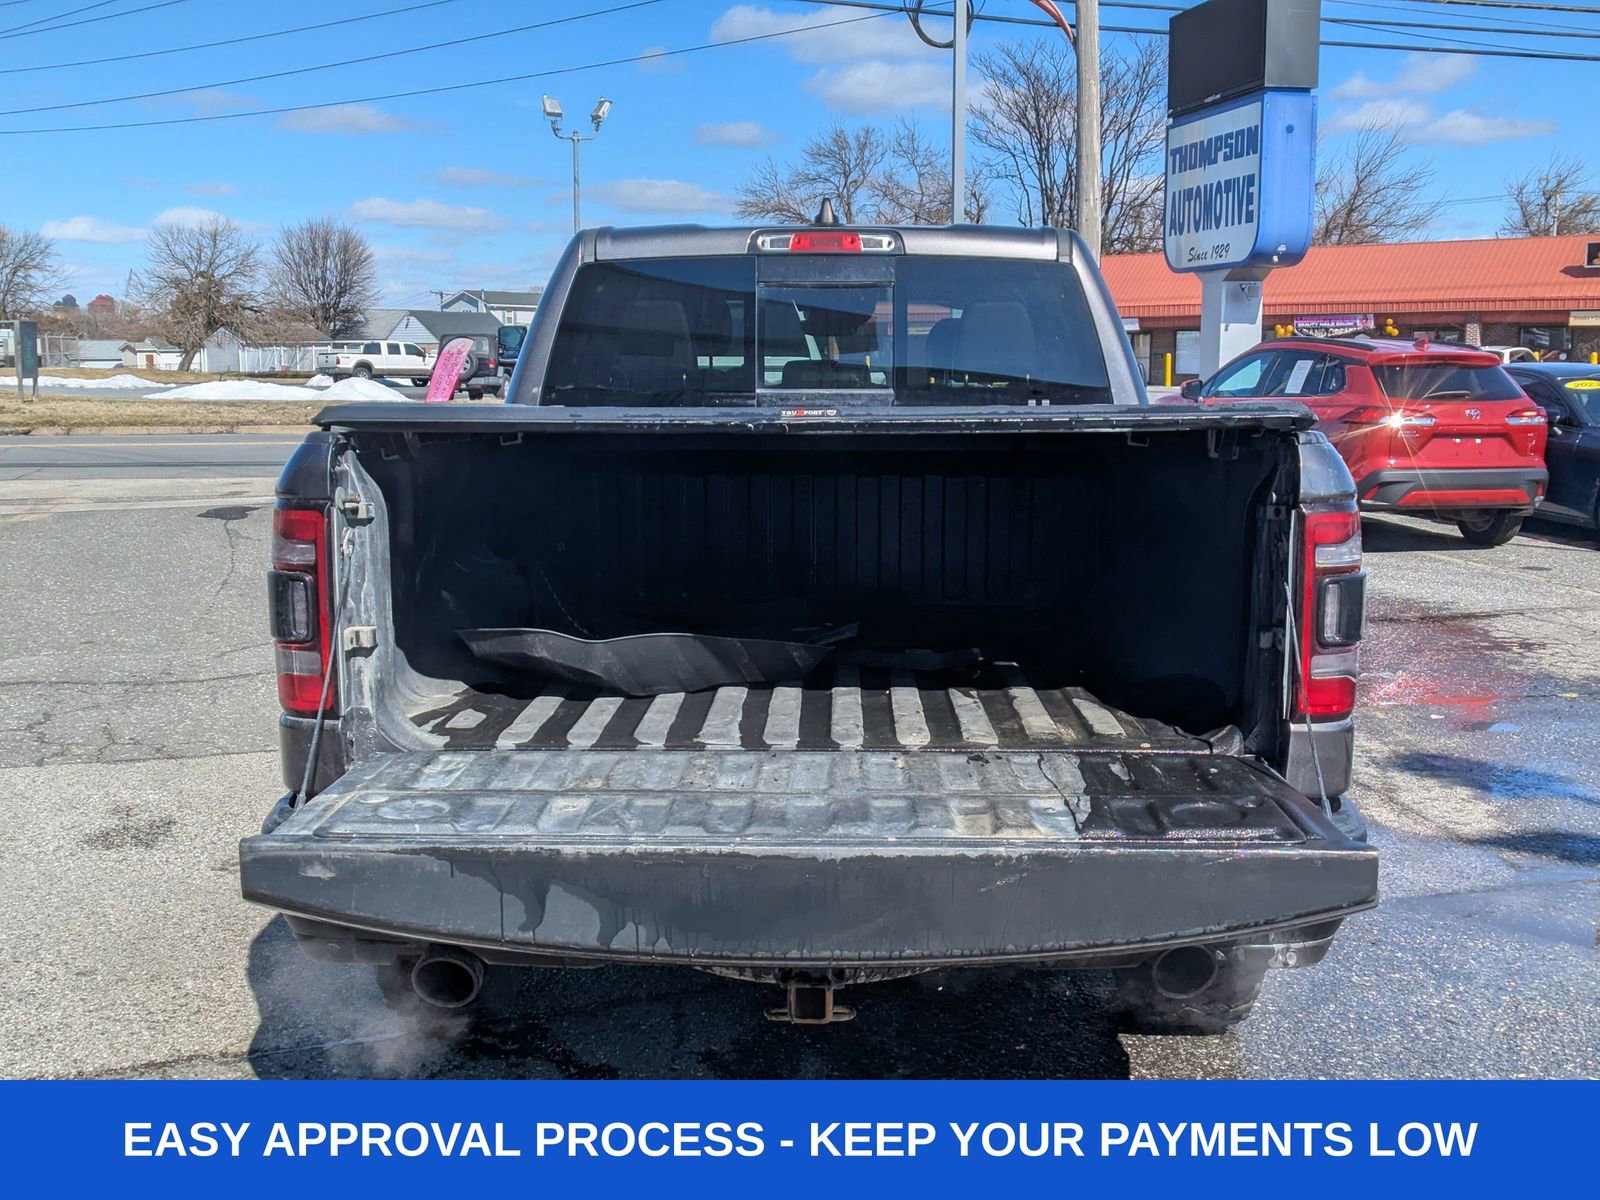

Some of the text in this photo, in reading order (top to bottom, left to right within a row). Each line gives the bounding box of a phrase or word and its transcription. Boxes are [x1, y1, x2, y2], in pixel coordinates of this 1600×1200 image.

[1170, 124, 1259, 172] THOMPSON
[1169, 173, 1255, 237] AUTOMOTIVE
[1188, 243, 1230, 262] Since 1929
